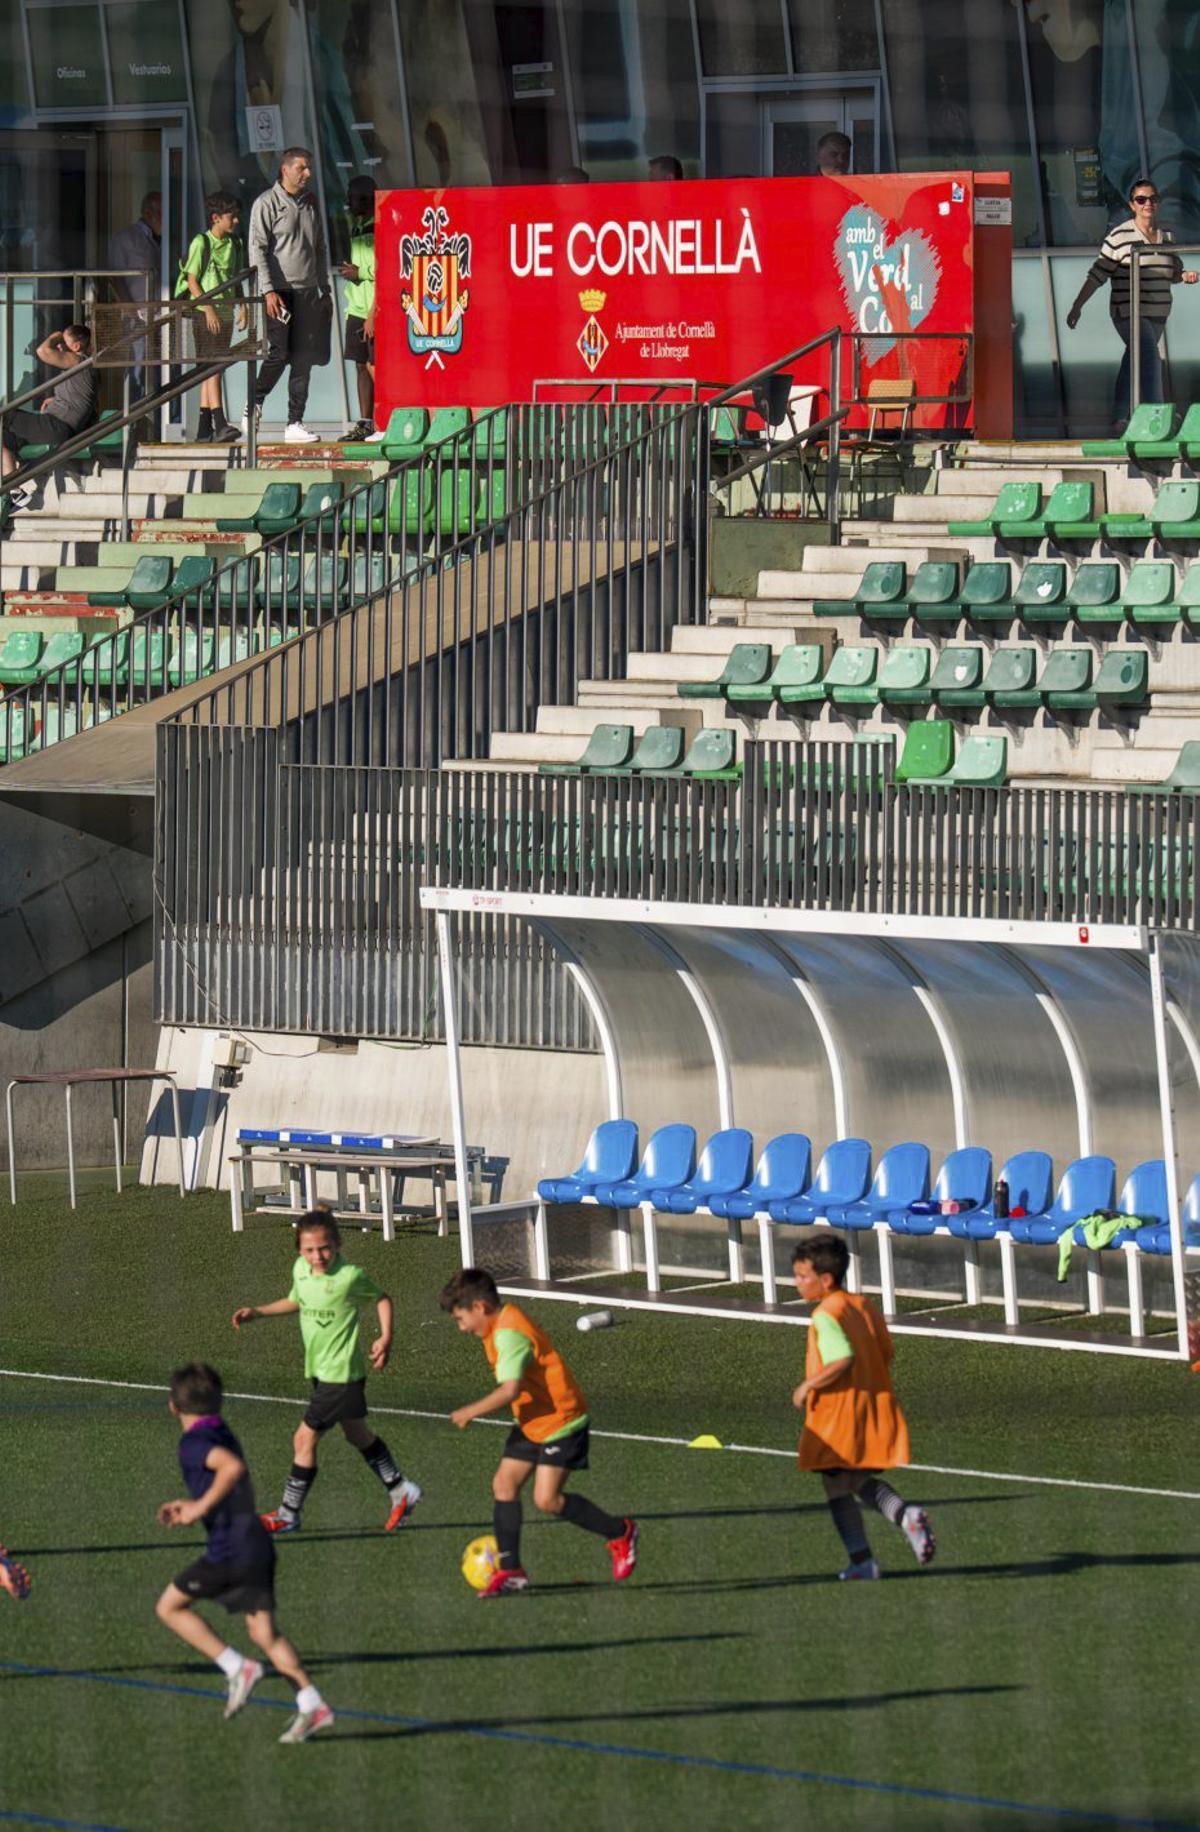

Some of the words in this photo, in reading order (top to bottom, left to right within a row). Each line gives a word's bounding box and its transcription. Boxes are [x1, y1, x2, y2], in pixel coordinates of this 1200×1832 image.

[509, 223, 553, 277] UE
[567, 207, 762, 276] CORNELLÀ
[846, 216, 875, 244] amb
[873, 232, 884, 260] el
[847, 243, 911, 293] Verd
[910, 284, 923, 310] al
[859, 296, 893, 334] Co
[615, 322, 665, 344] Ajuntament
[666, 322, 677, 338] de
[640, 342, 650, 358] de
[651, 342, 690, 362] Llobregat
